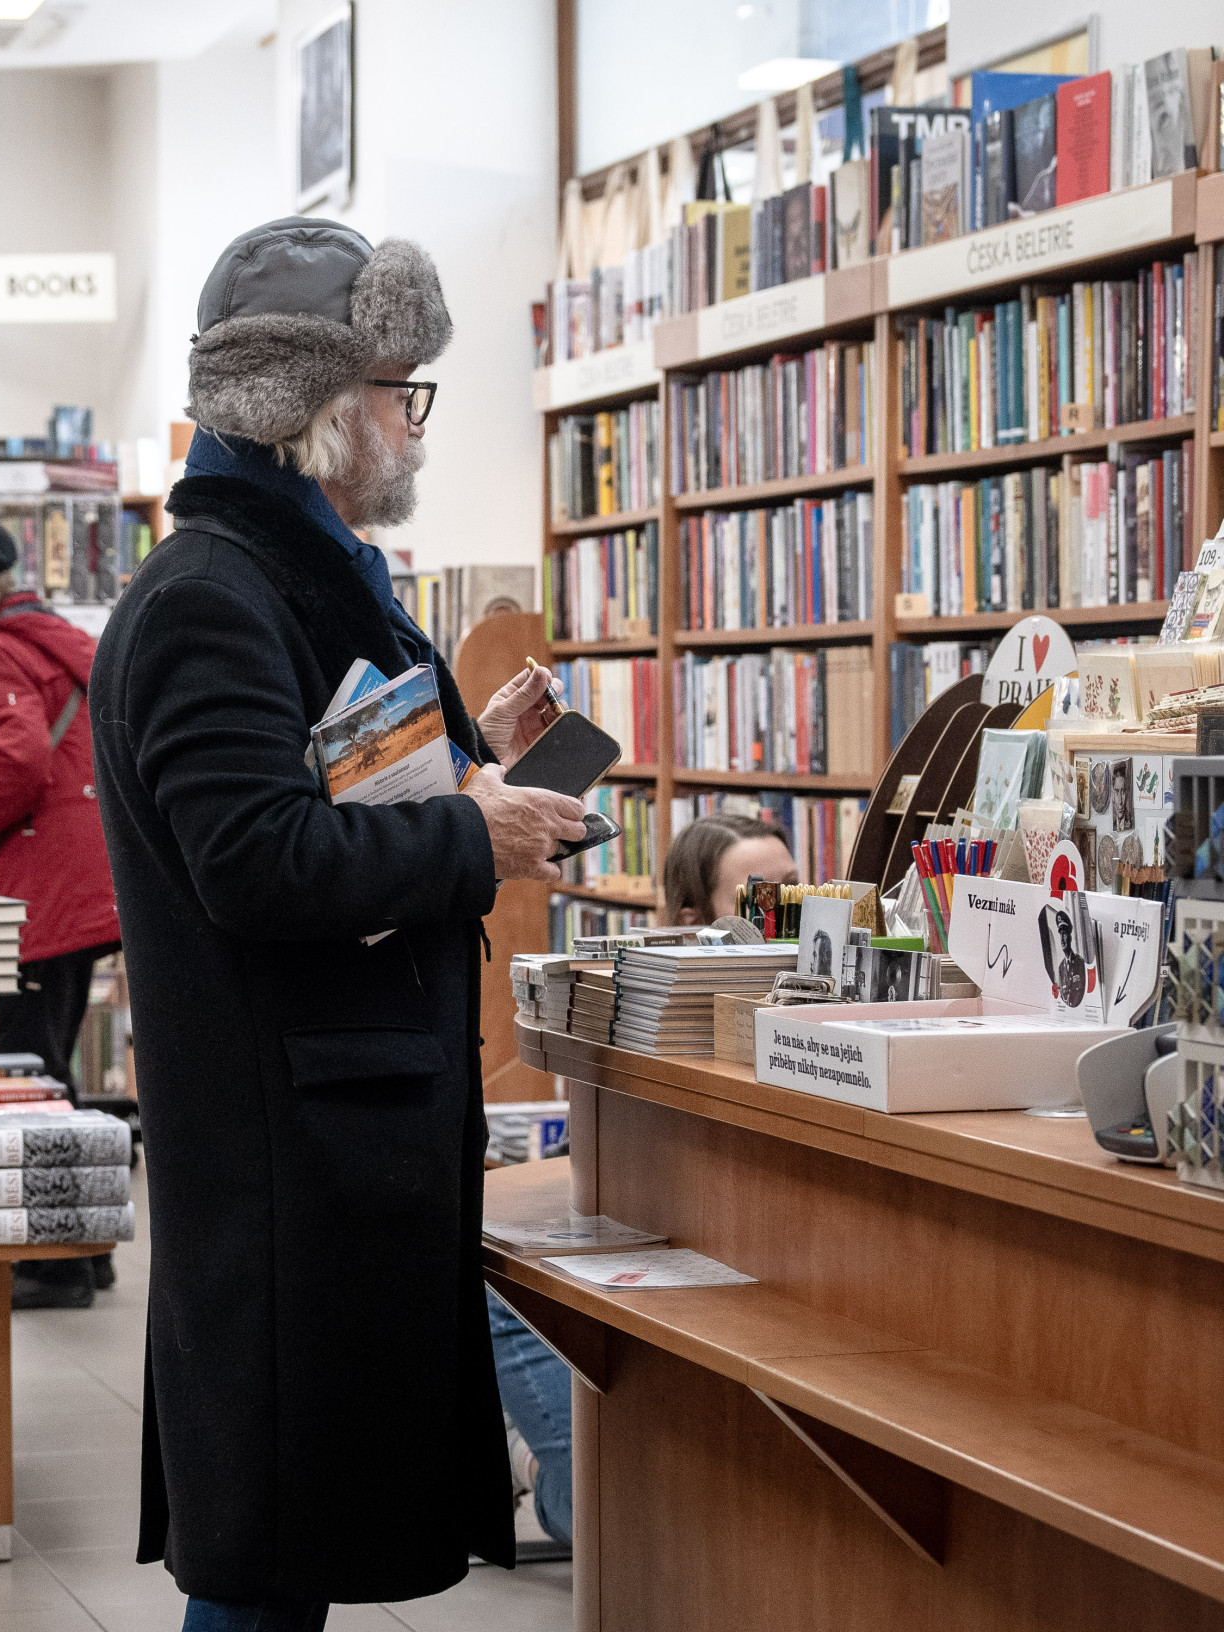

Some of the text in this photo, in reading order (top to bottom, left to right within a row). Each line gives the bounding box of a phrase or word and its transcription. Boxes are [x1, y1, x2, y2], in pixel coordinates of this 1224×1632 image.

[966, 220, 1074, 274] ČESKÁ BELETRIE
[7, 271, 98, 297] BOOKS
[1014, 635, 1026, 672] I
[968, 893, 1016, 915] Vezmi mák
[1114, 919, 1150, 942] a přispěj!
[773, 1030, 863, 1064] Je na nás, aby se na jejich
[769, 1052, 871, 1089] příběhy nikdy nezapomnělo.
